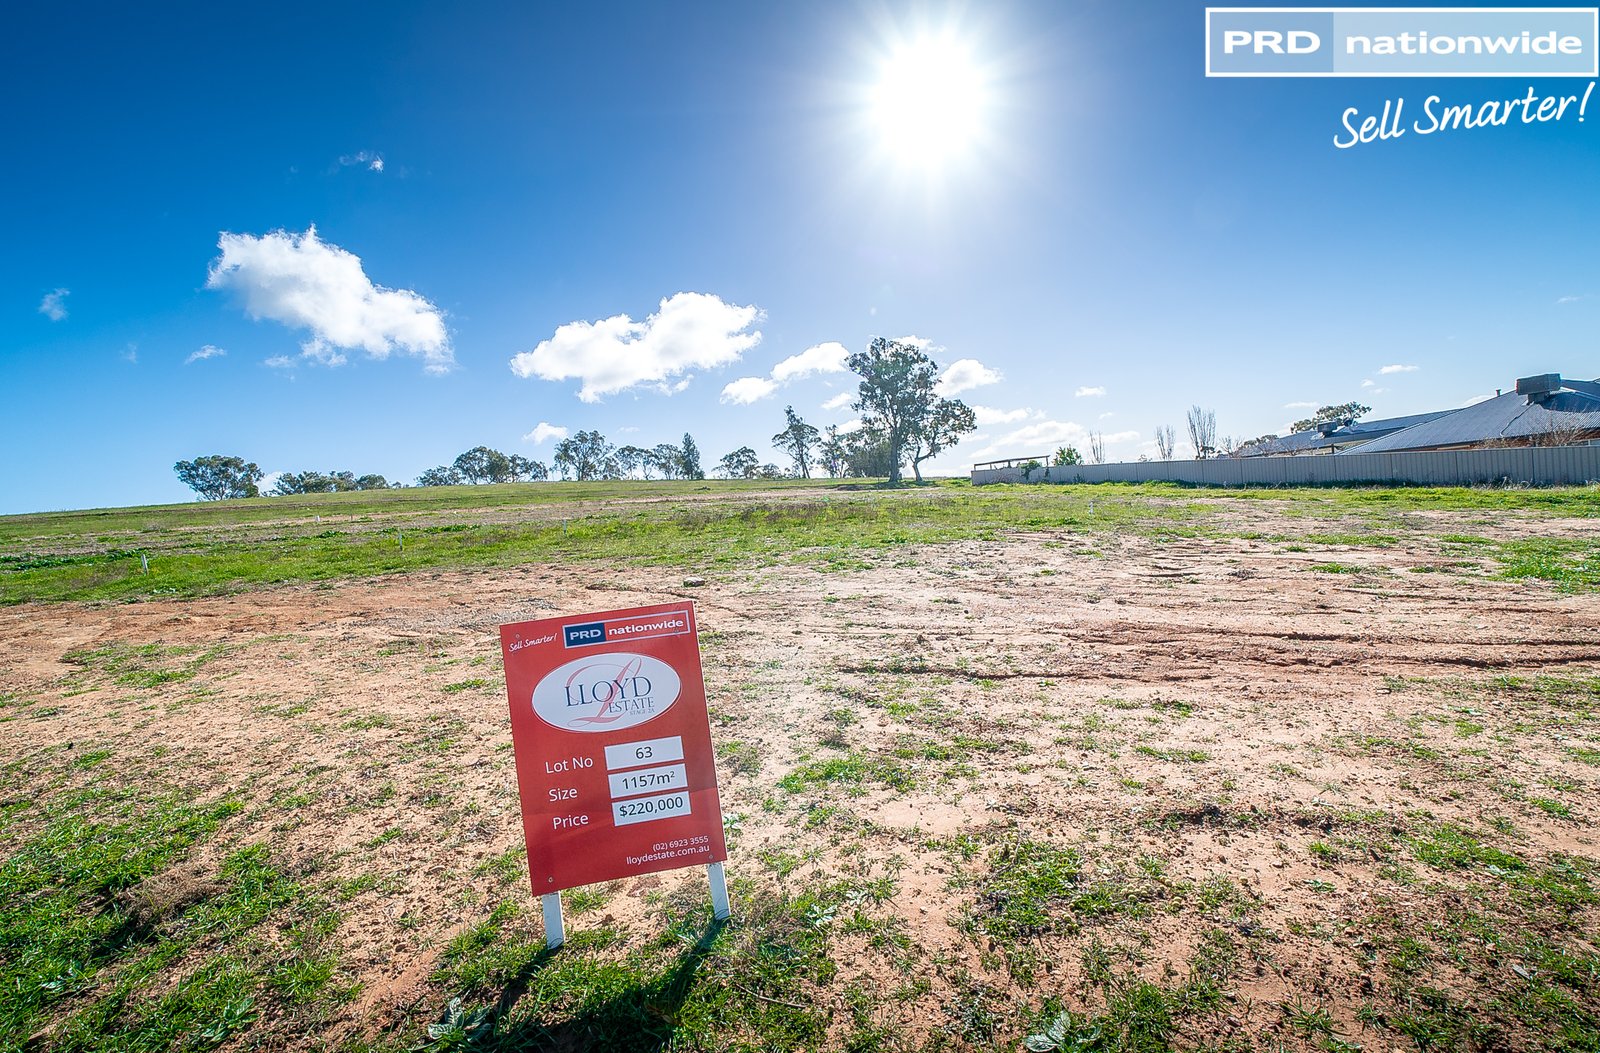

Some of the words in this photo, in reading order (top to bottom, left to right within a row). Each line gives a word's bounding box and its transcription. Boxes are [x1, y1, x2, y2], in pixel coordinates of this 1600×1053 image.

[569, 629, 601, 641] PRD
[608, 619, 684, 636] nationwide
[508, 639, 523, 652] Sell
[523, 632, 558, 648] Smarter!
[565, 676, 652, 707] LLOYD
[609, 696, 655, 713] ESTATE
[635, 746, 653, 760] 63
[545, 761, 569, 774] Lot
[572, 756, 594, 770] No
[548, 787, 578, 802] Size
[619, 796, 684, 817] $220,000
[552, 814, 589, 830] Price
[652, 842, 668, 852] (02)
[669, 839, 689, 849] 6923
[690, 835, 709, 845] 3555
[626, 845, 710, 866] lloydestate.com.au
